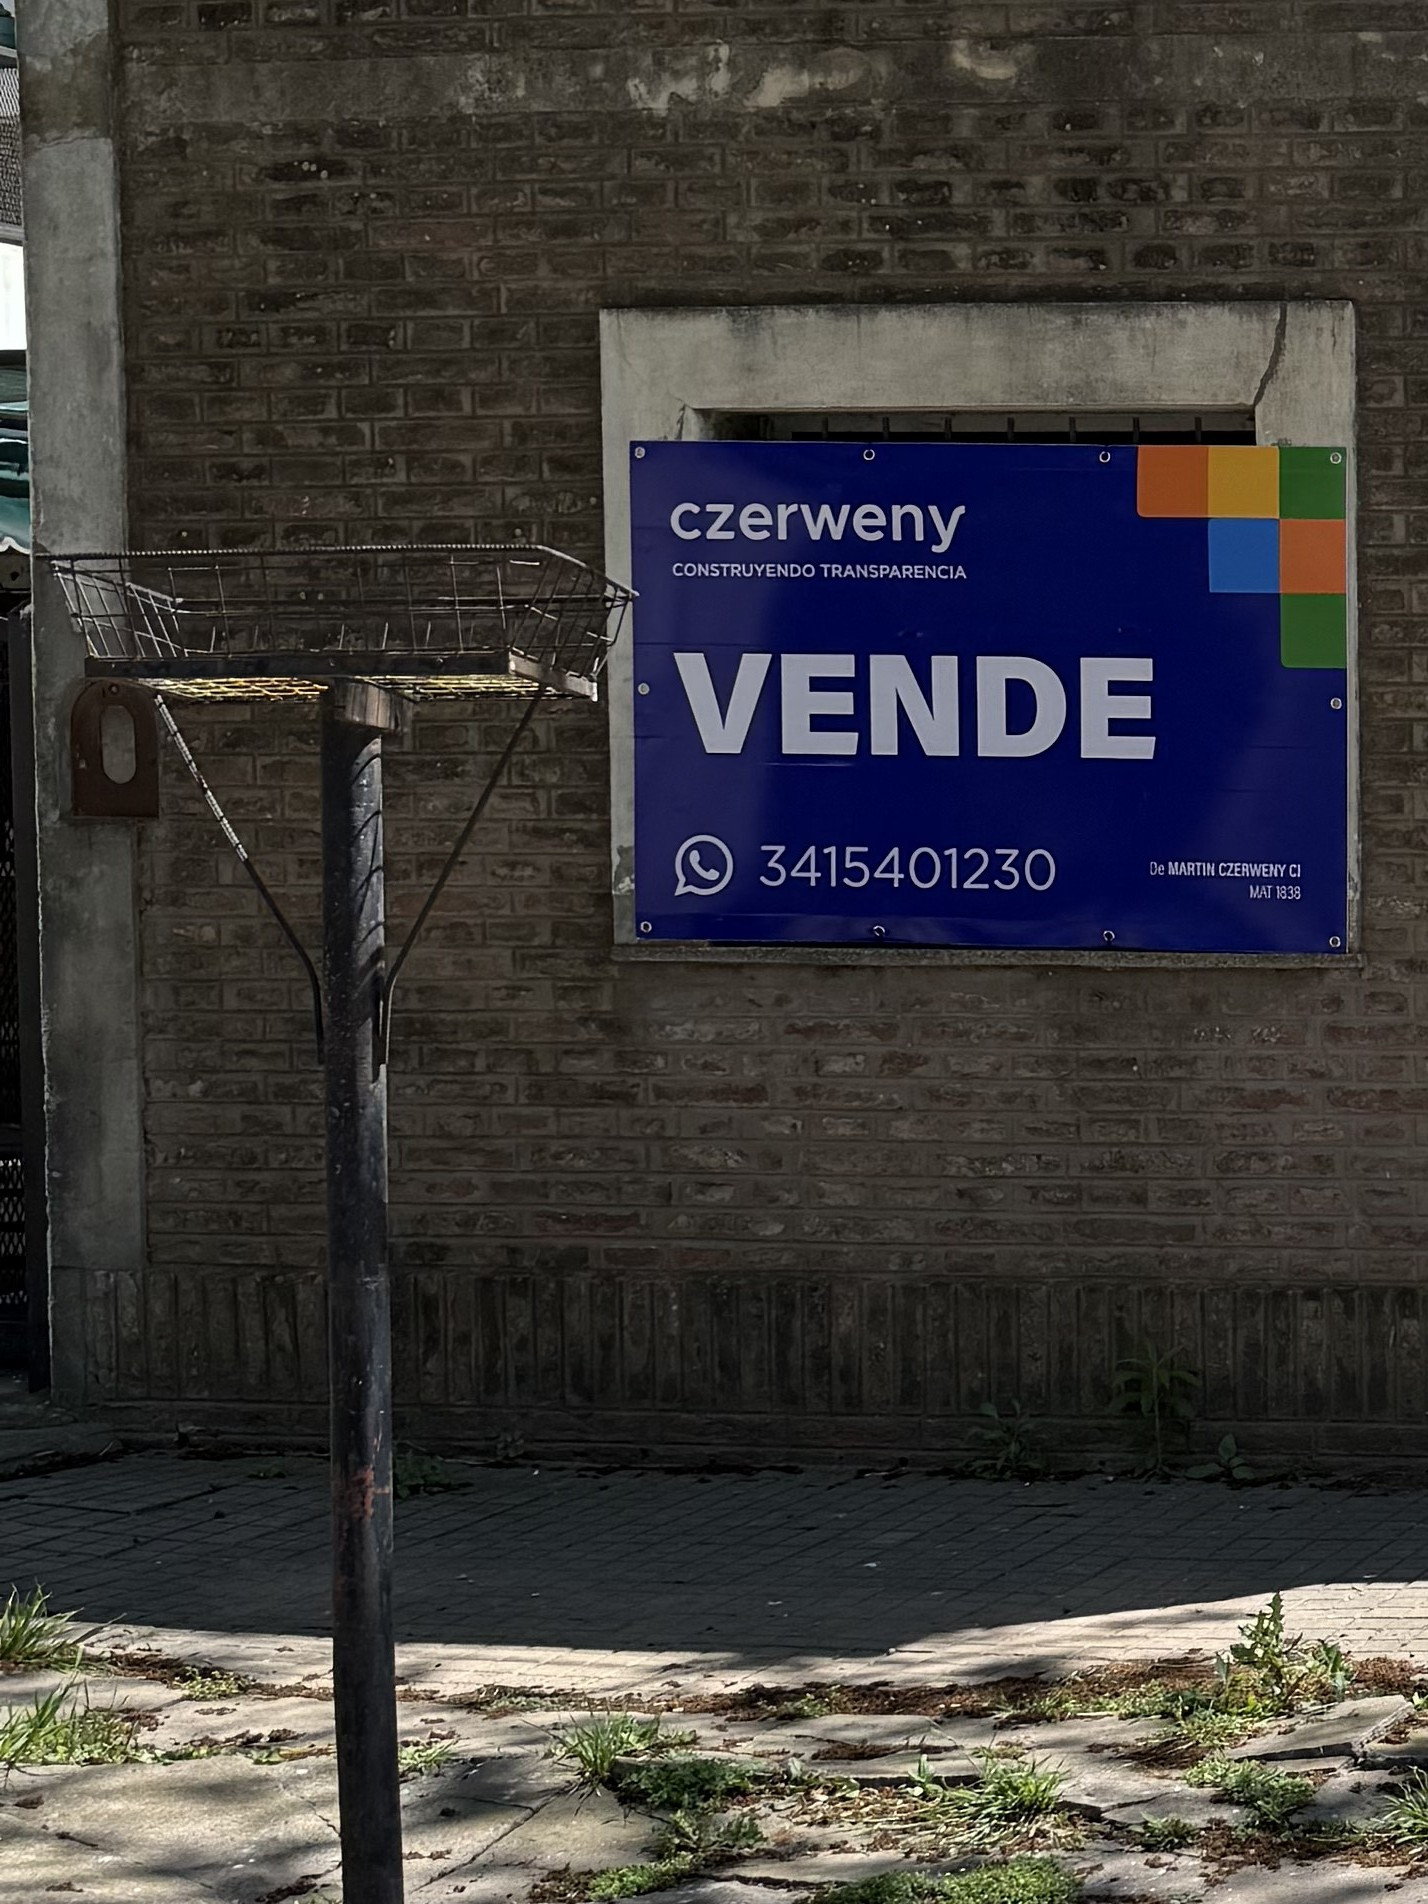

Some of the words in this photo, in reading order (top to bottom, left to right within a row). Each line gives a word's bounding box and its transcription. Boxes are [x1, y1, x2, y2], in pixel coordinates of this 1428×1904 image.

[670, 502, 966, 553] czerweny
[672, 563, 816, 578] CONSTRUYENDO
[819, 563, 967, 580] TRANSPARENCIA
[673, 652, 1157, 760] VENDE
[759, 845, 1056, 891] 3415401230
[1150, 861, 1165, 876] De
[1168, 862, 1215, 876] MARTIN
[1218, 863, 1287, 878] CZERWENY
[1249, 884, 1273, 899] MAT
[1275, 885, 1301, 900] 1838
